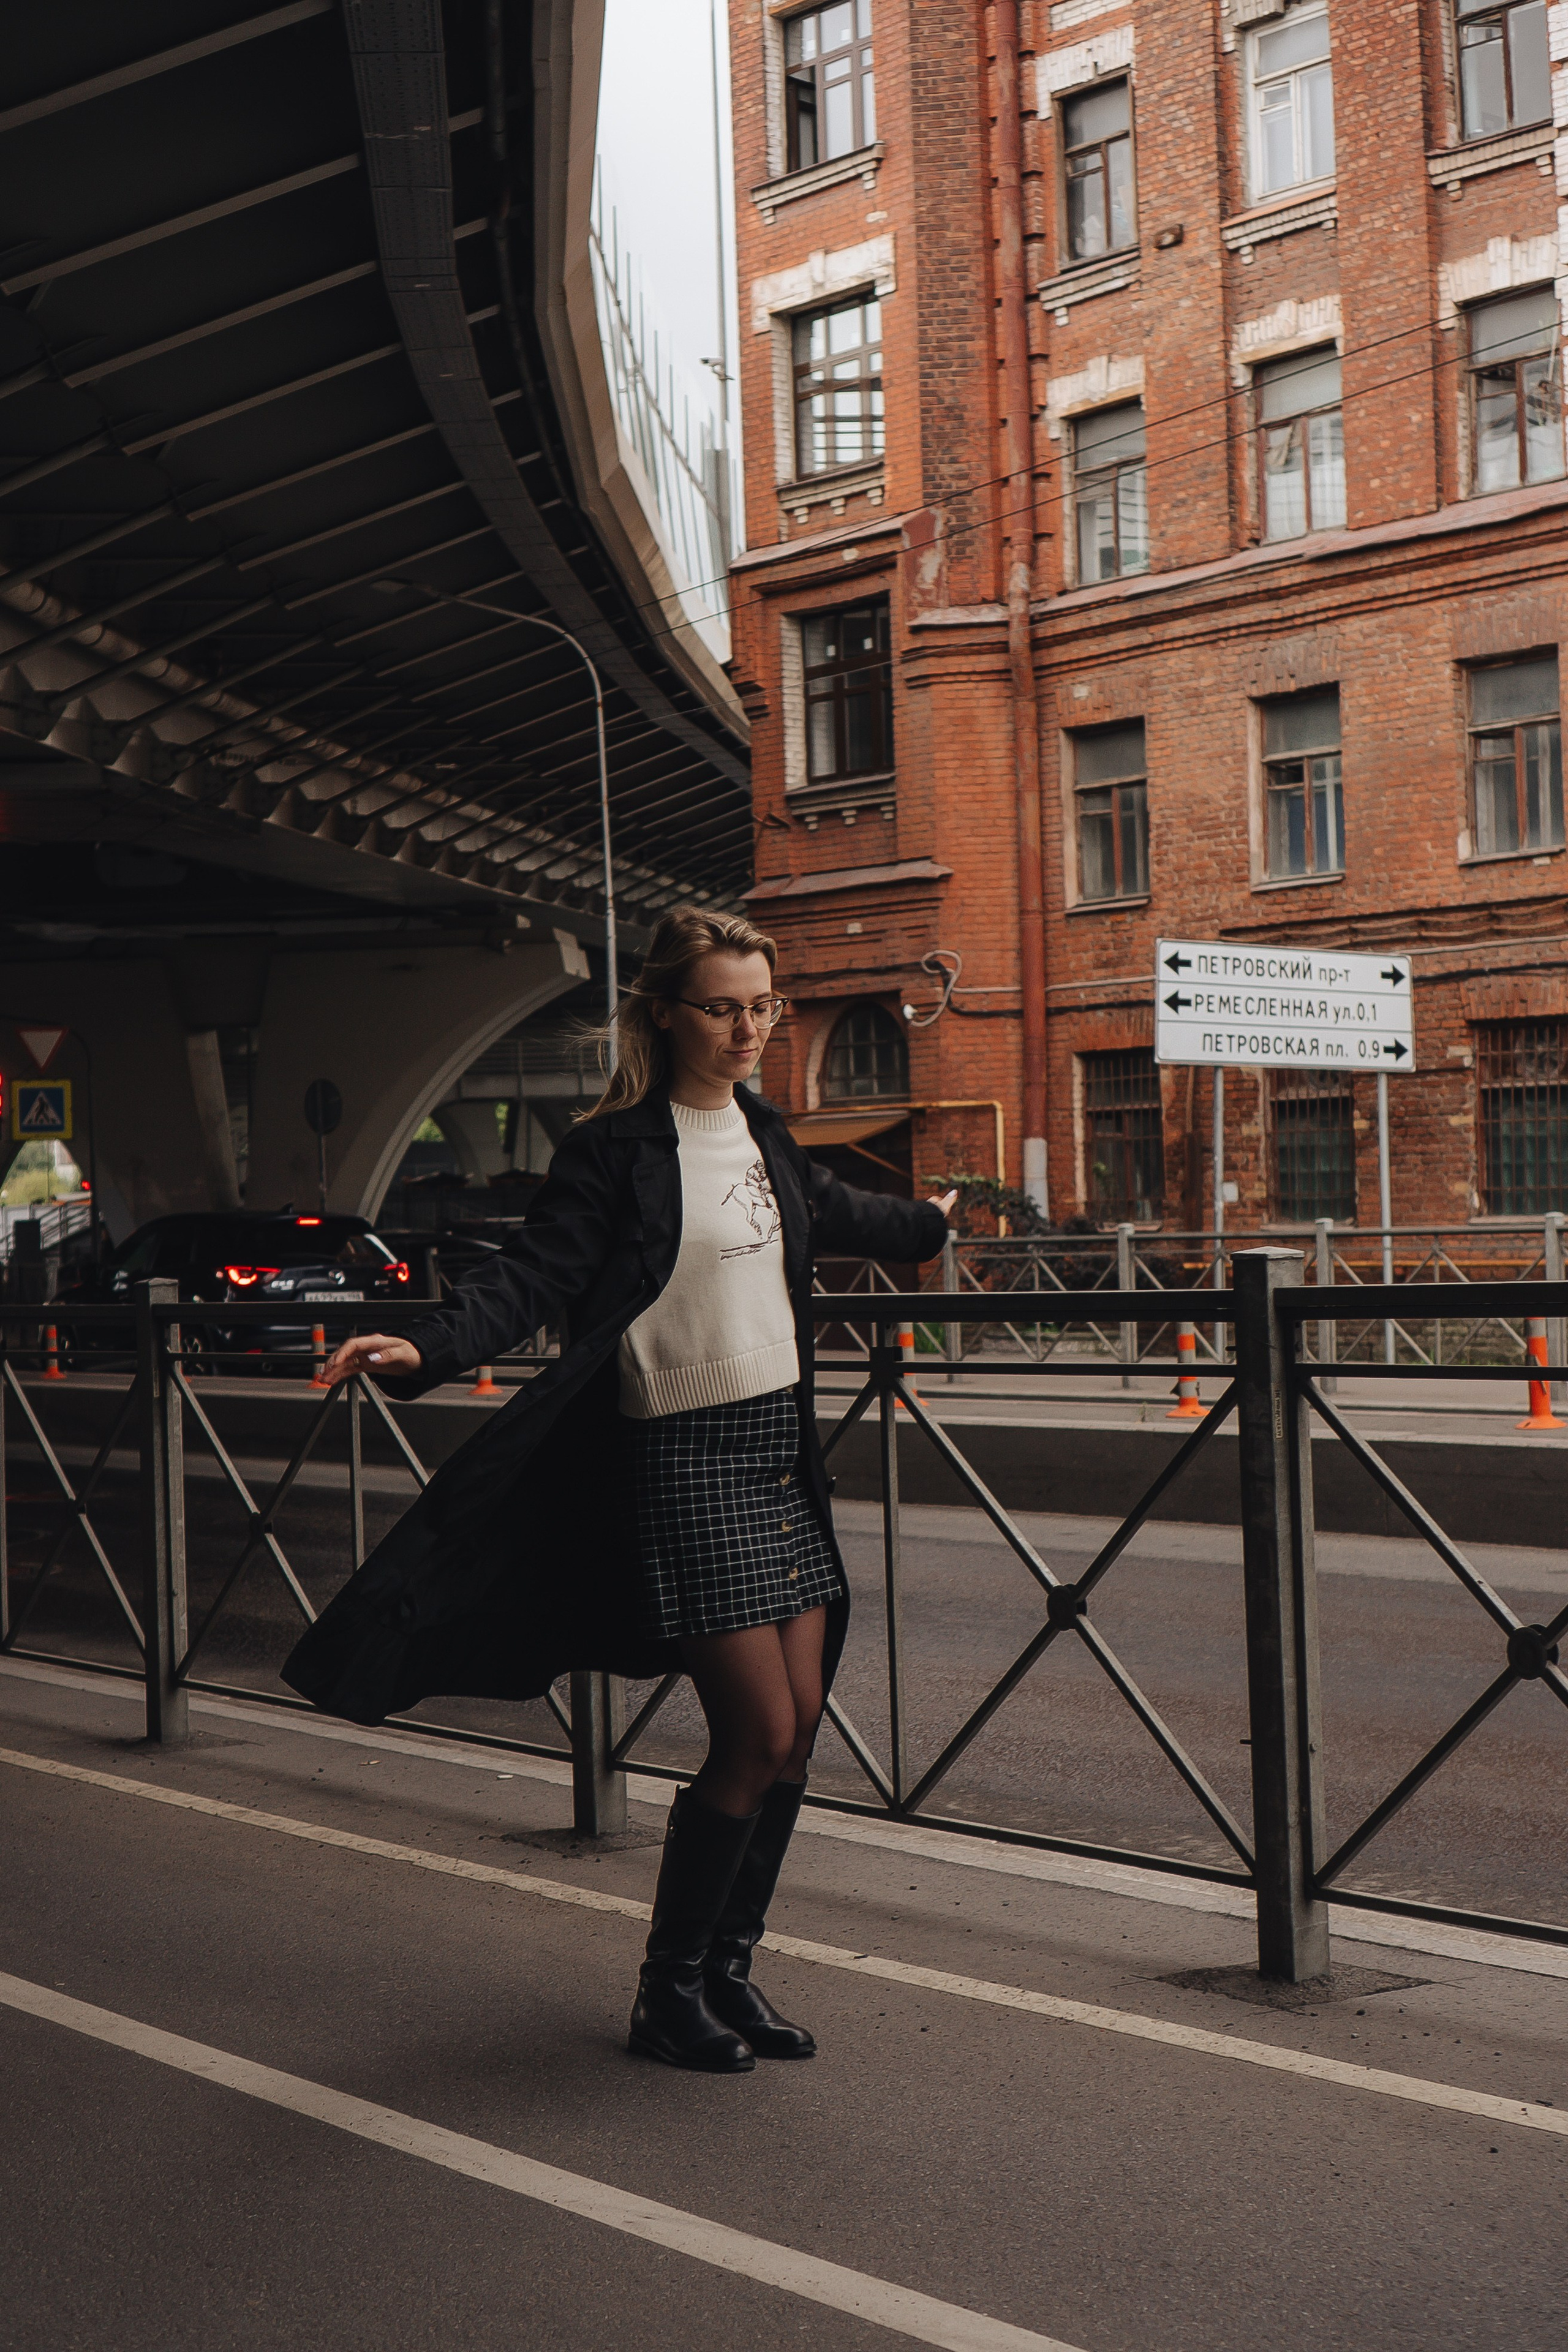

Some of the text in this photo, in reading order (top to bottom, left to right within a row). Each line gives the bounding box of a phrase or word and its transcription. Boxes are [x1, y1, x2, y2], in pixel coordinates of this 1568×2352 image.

[1198, 955, 1351, 987] ПЕТРОВСКИЙ пр-т
[1194, 993, 1328, 1019] РЕМЕСЛЕННАЯ
[1202, 1033, 1380, 1059] ПЕТРОВСКАЯ пл. 0,9
